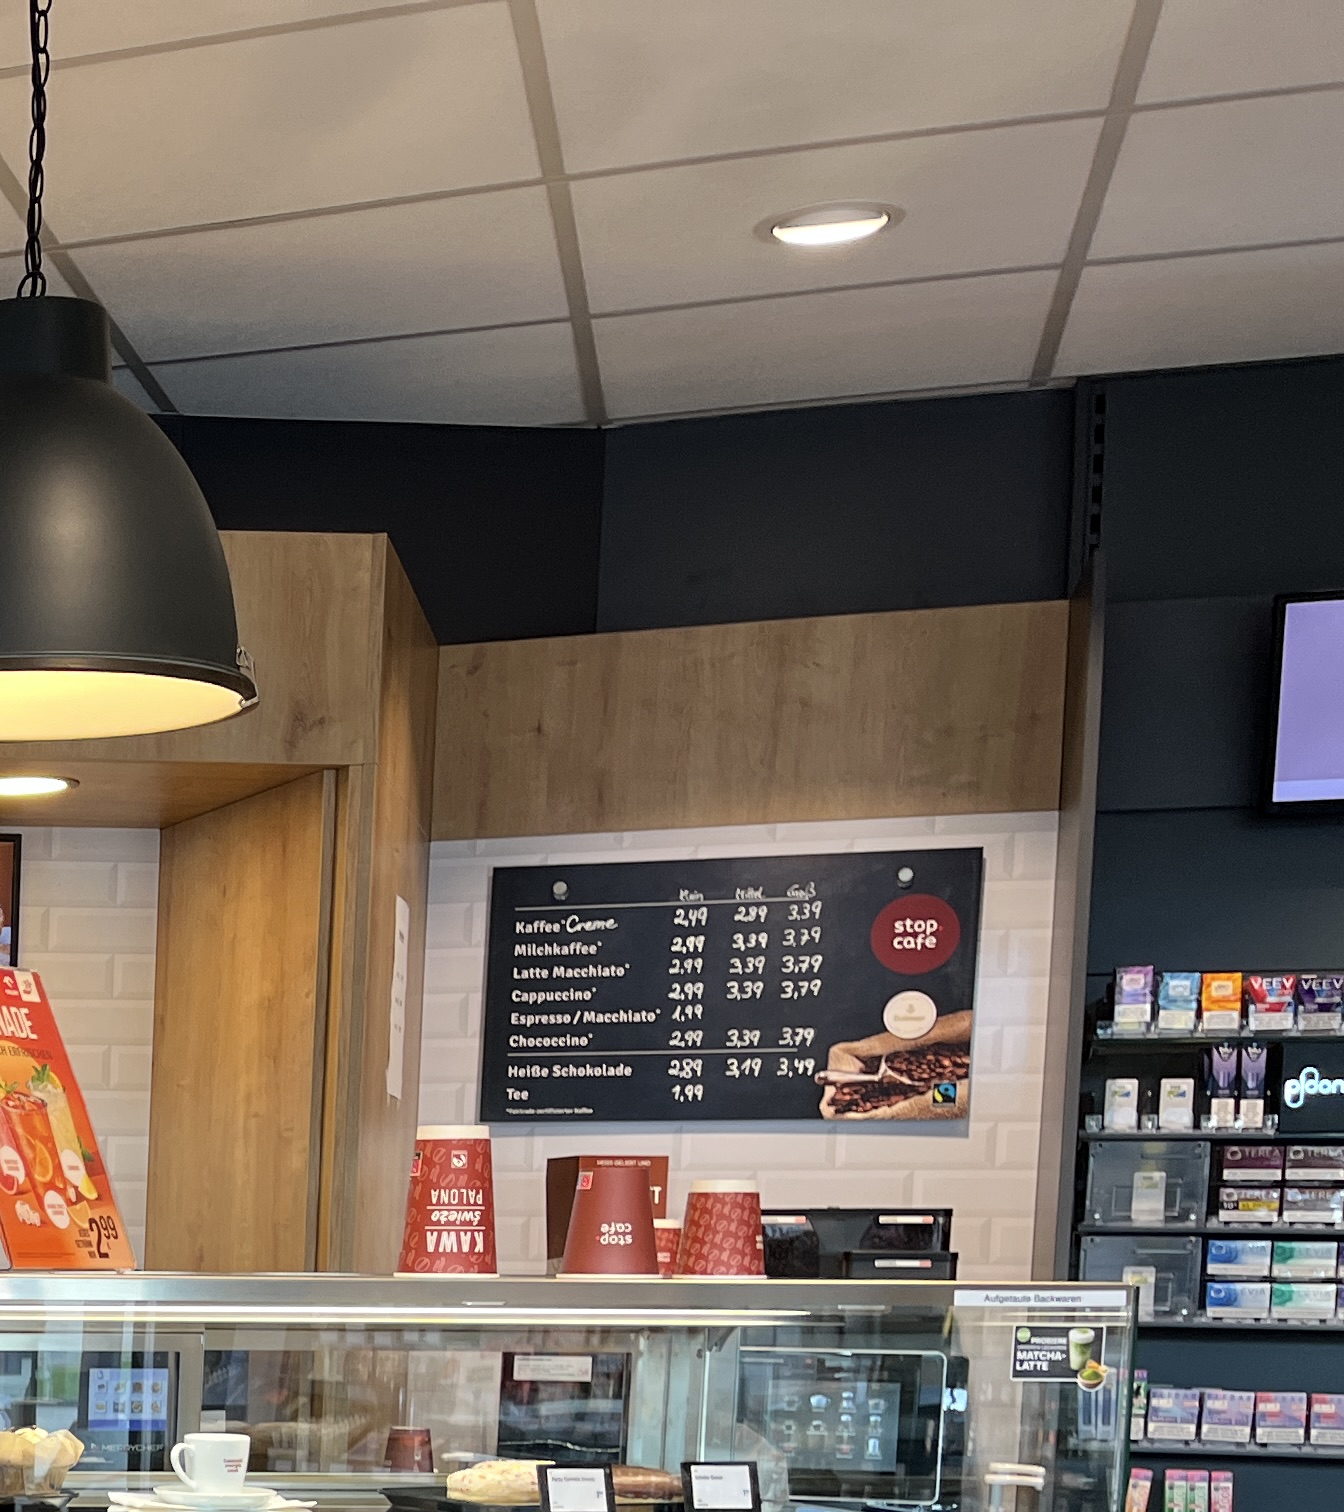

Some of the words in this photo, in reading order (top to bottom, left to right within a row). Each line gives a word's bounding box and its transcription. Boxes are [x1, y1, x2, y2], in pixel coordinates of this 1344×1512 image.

[566, 915, 618, 933] Creme
[894, 918, 938, 935] stop
[893, 933, 937, 950] cafe
[669, 957, 703, 975] 2,99
[781, 954, 823, 973] 3,79
[513, 967, 549, 979] Latte
[668, 982, 704, 1000] 2,99
[726, 981, 764, 1001] 3,39
[780, 978, 822, 1000] 3,79
[1249, 976, 1296, 990] VEEV
[511, 1013, 571, 1027] Espresso
[669, 1030, 703, 1047] 2,99
[726, 1029, 761, 1048] 3,39
[778, 1027, 815, 1047] 3,79
[508, 1065, 549, 1078] Heiße
[552, 1063, 633, 1077] Schokolade
[777, 1057, 816, 1079] 3,49
[506, 1088, 529, 1100] Tee
[671, 1084, 703, 1102] 1,99
[430, 1189, 483, 1204] PALONA
[600, 1222, 632, 1234] cafe
[426, 1231, 484, 1253] KAWA
[600, 1233, 633, 1246] stop
[1033, 1294, 1082, 1303] Backwaren
[1015, 1361, 1049, 1372] LATTE
